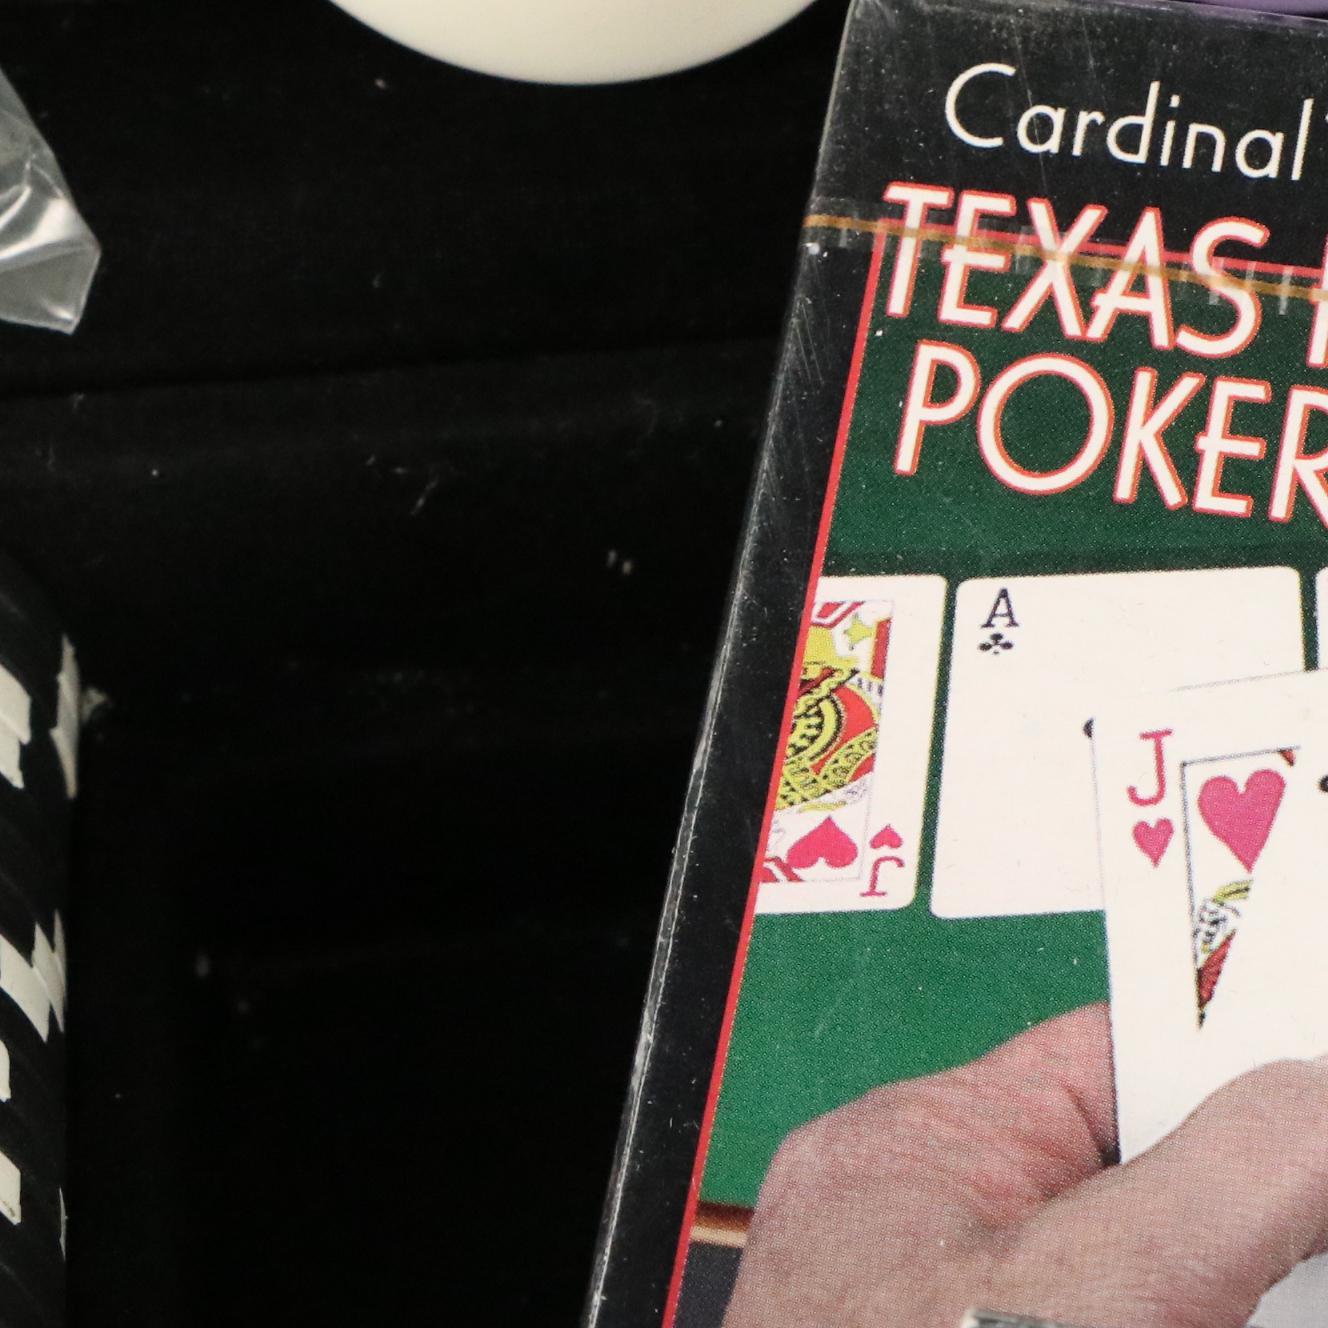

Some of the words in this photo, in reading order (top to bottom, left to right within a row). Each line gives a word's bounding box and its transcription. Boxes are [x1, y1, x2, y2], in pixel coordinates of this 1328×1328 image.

[883, 180, 1270, 359] TEXAS
[980, 587, 1020, 630] A
[1126, 728, 1173, 808] J
[859, 855, 905, 898] J
